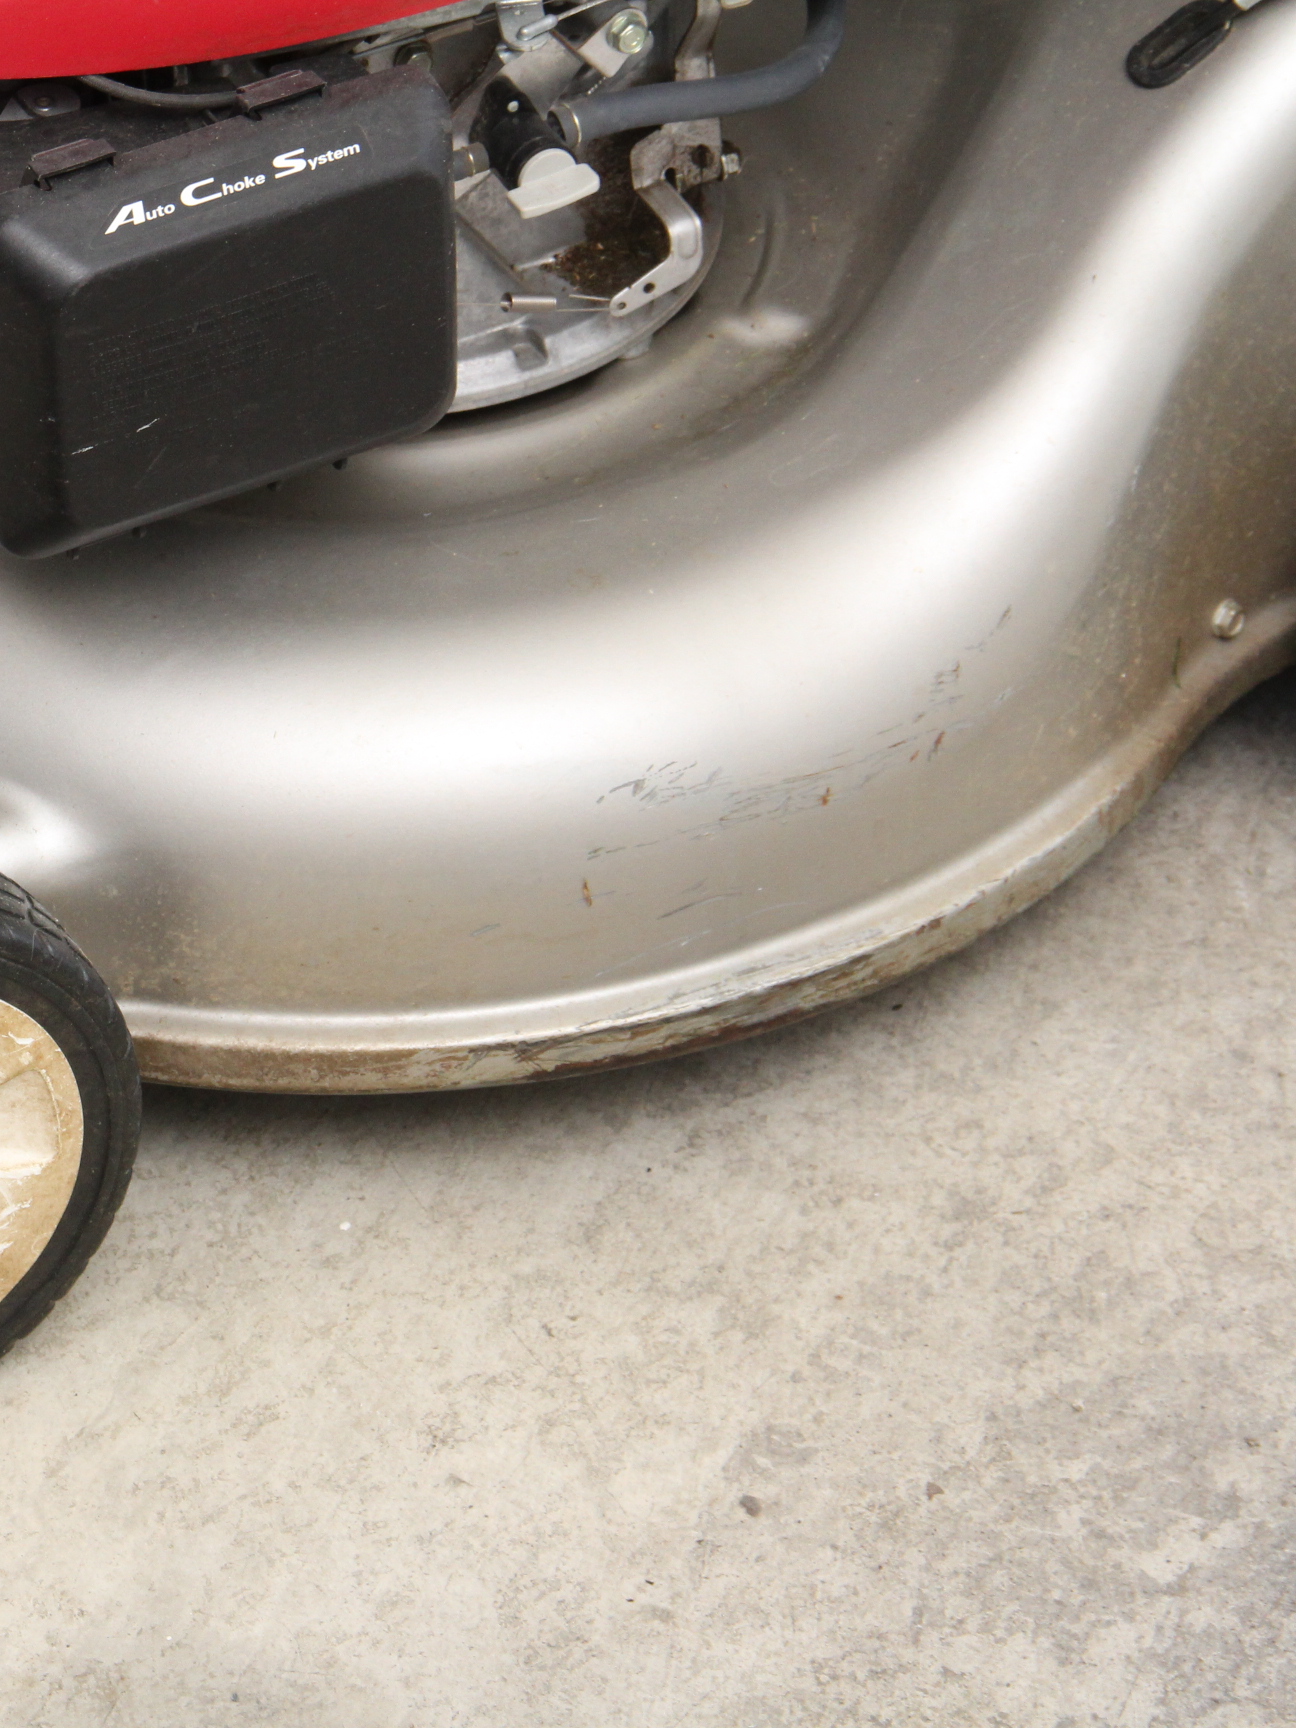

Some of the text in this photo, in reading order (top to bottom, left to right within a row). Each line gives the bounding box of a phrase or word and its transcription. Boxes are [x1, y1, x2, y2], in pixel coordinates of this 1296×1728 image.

[104, 143, 361, 235] Auto Choke System
